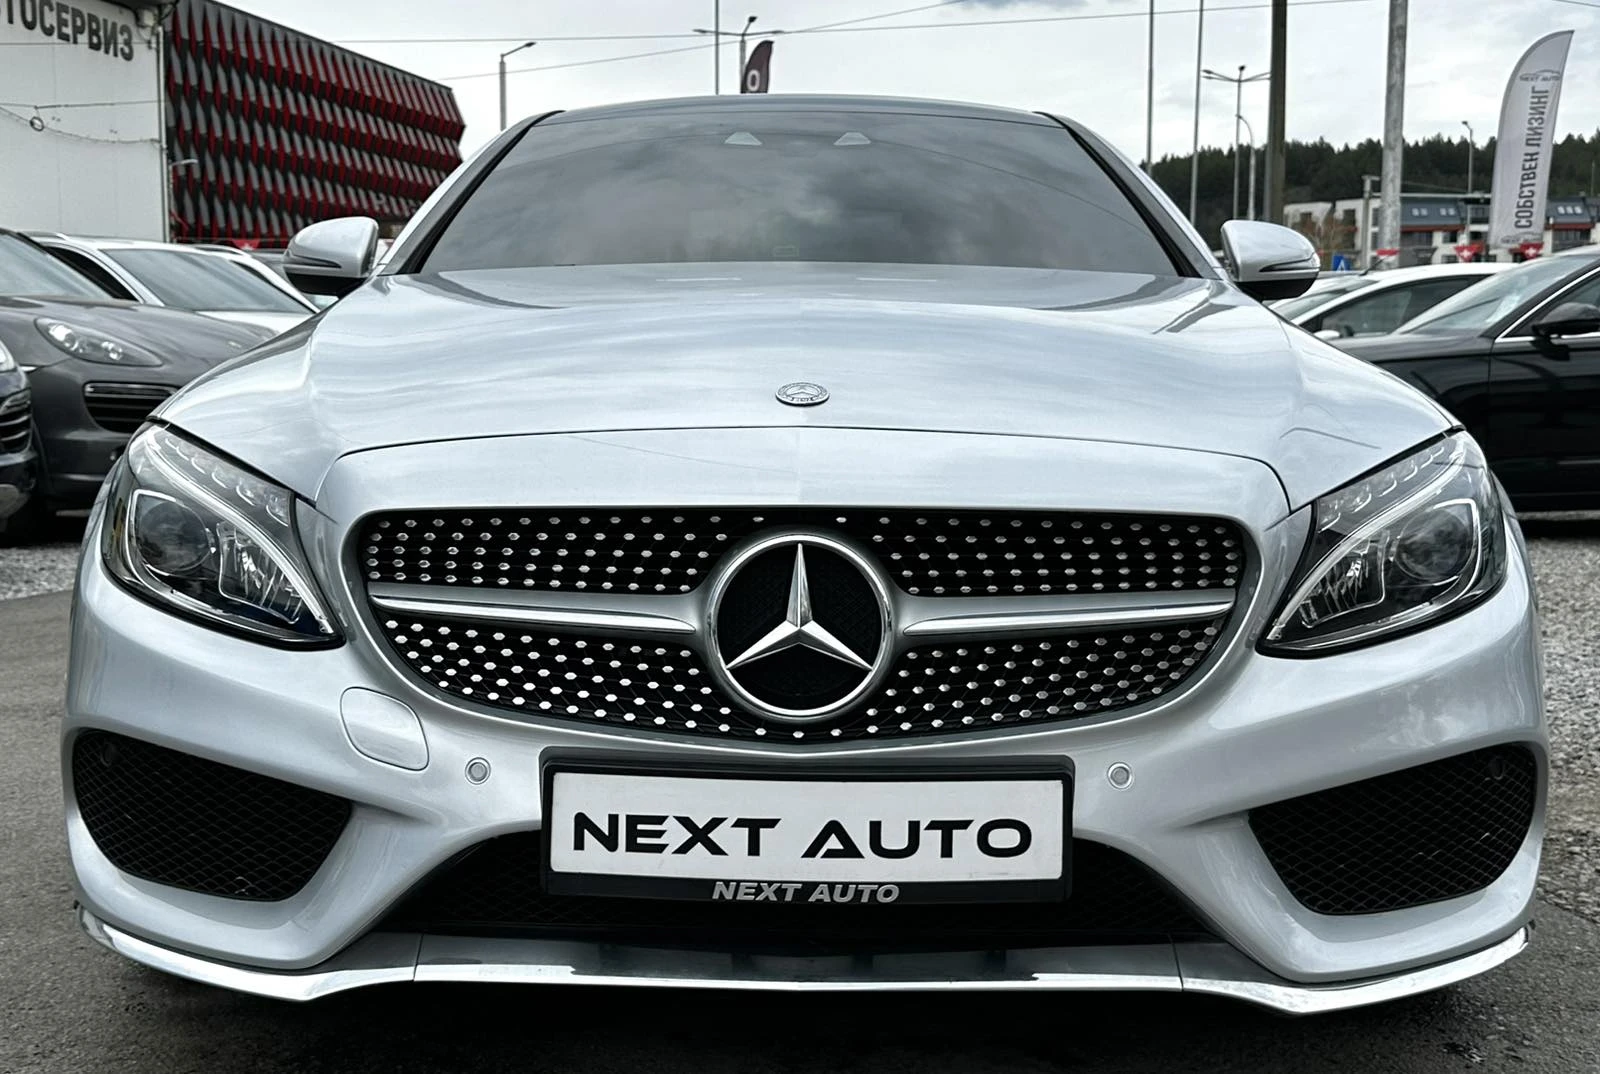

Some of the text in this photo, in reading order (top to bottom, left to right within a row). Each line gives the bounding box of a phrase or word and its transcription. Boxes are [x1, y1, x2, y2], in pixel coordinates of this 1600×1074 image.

[1525, 85, 1549, 148] ЛИЗИНГ
[1514, 151, 1540, 229] СОБСТВЕН
[573, 812, 1032, 860] NEXT AUTO
[711, 881, 900, 904] NEXT AUTO
